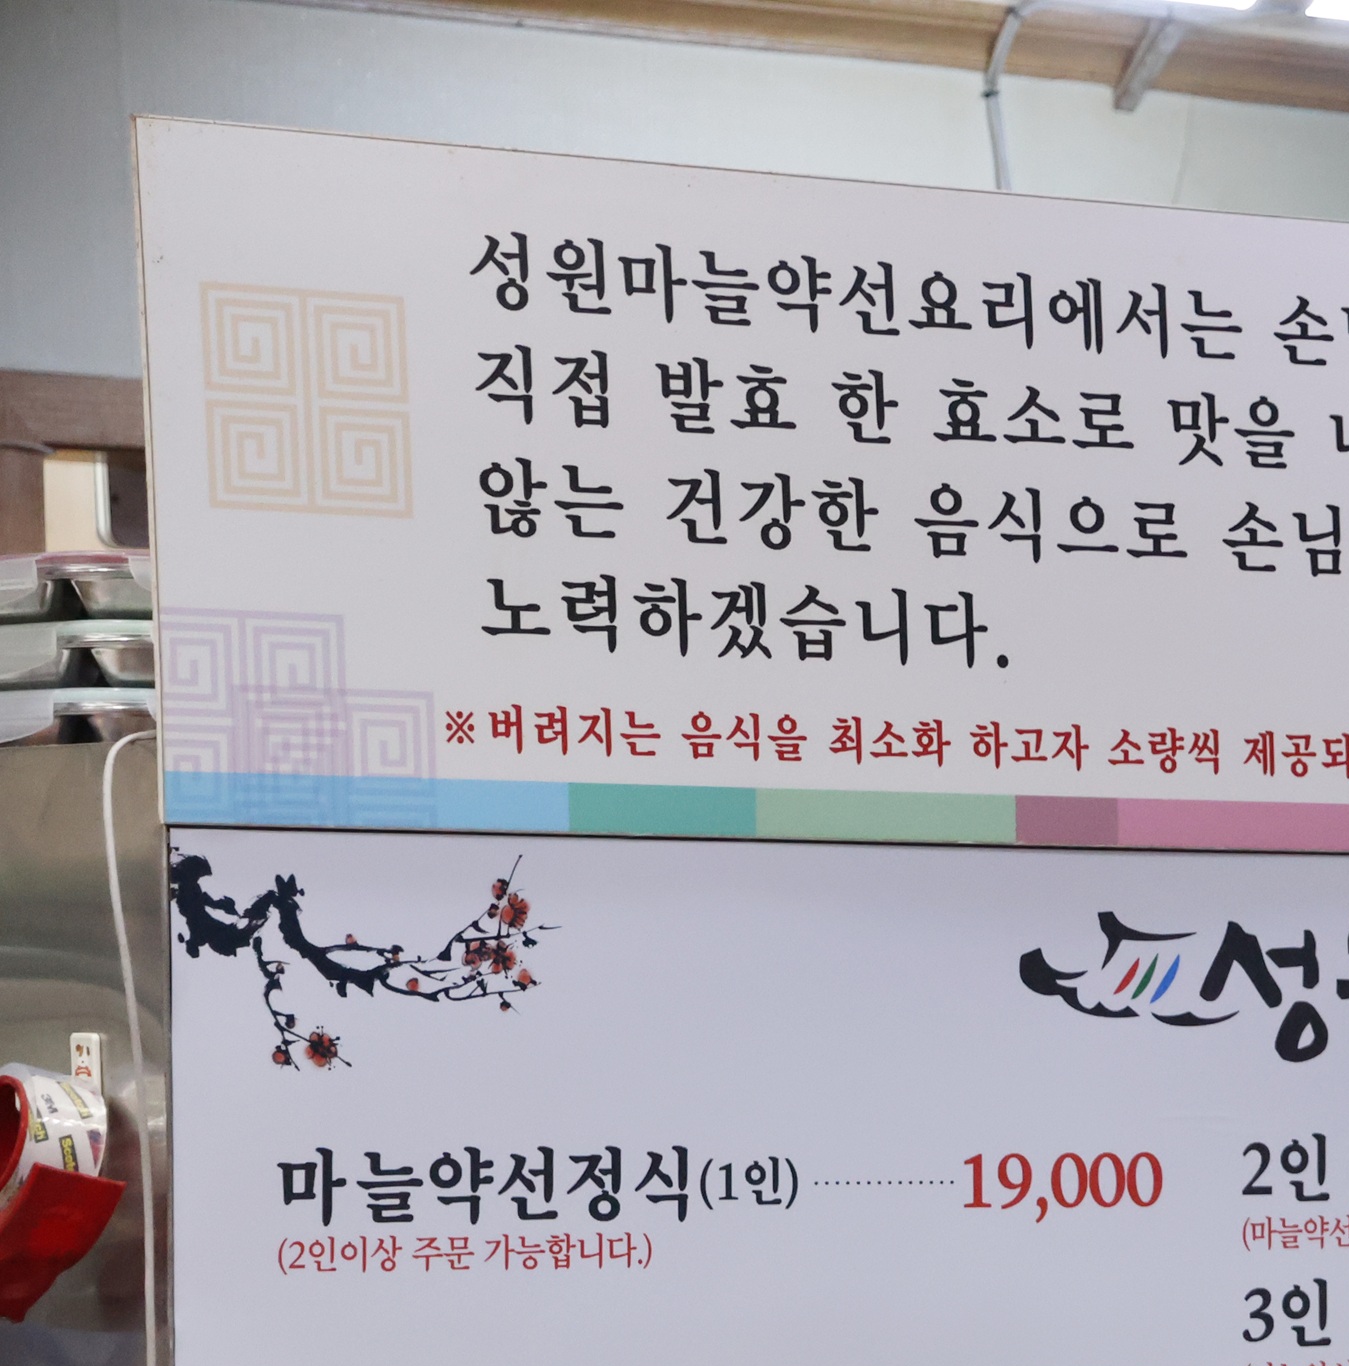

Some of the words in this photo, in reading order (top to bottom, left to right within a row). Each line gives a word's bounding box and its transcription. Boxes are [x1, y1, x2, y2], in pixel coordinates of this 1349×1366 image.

[469, 232, 1243, 360] 성원마늘약선요리에서는
[475, 344, 609, 428] 직접
[655, 357, 797, 434] 발효
[831, 369, 899, 444] 한
[933, 378, 1134, 449] 효소로
[1167, 392, 1295, 469] 맛을
[479, 457, 624, 538] 않는
[666, 468, 879, 552] 건강한
[914, 483, 1188, 564] 음식으로
[481, 574, 1009, 669] 노력하겠습니다.
[681, 711, 807, 761] 음식을
[829, 716, 951, 767] 최소화
[970, 721, 1089, 771] 하고자
[1108, 727, 1219, 775] 소량씩
[964, 1152, 1163, 1223] 19,000
[1242, 1133, 1330, 1202] 2인
[278, 1235, 403, 1275] (2인이상
[412, 1237, 474, 1272] 주문
[485, 1232, 652, 1270] 가능합니다.)
[1242, 1278, 1331, 1347] 3인
